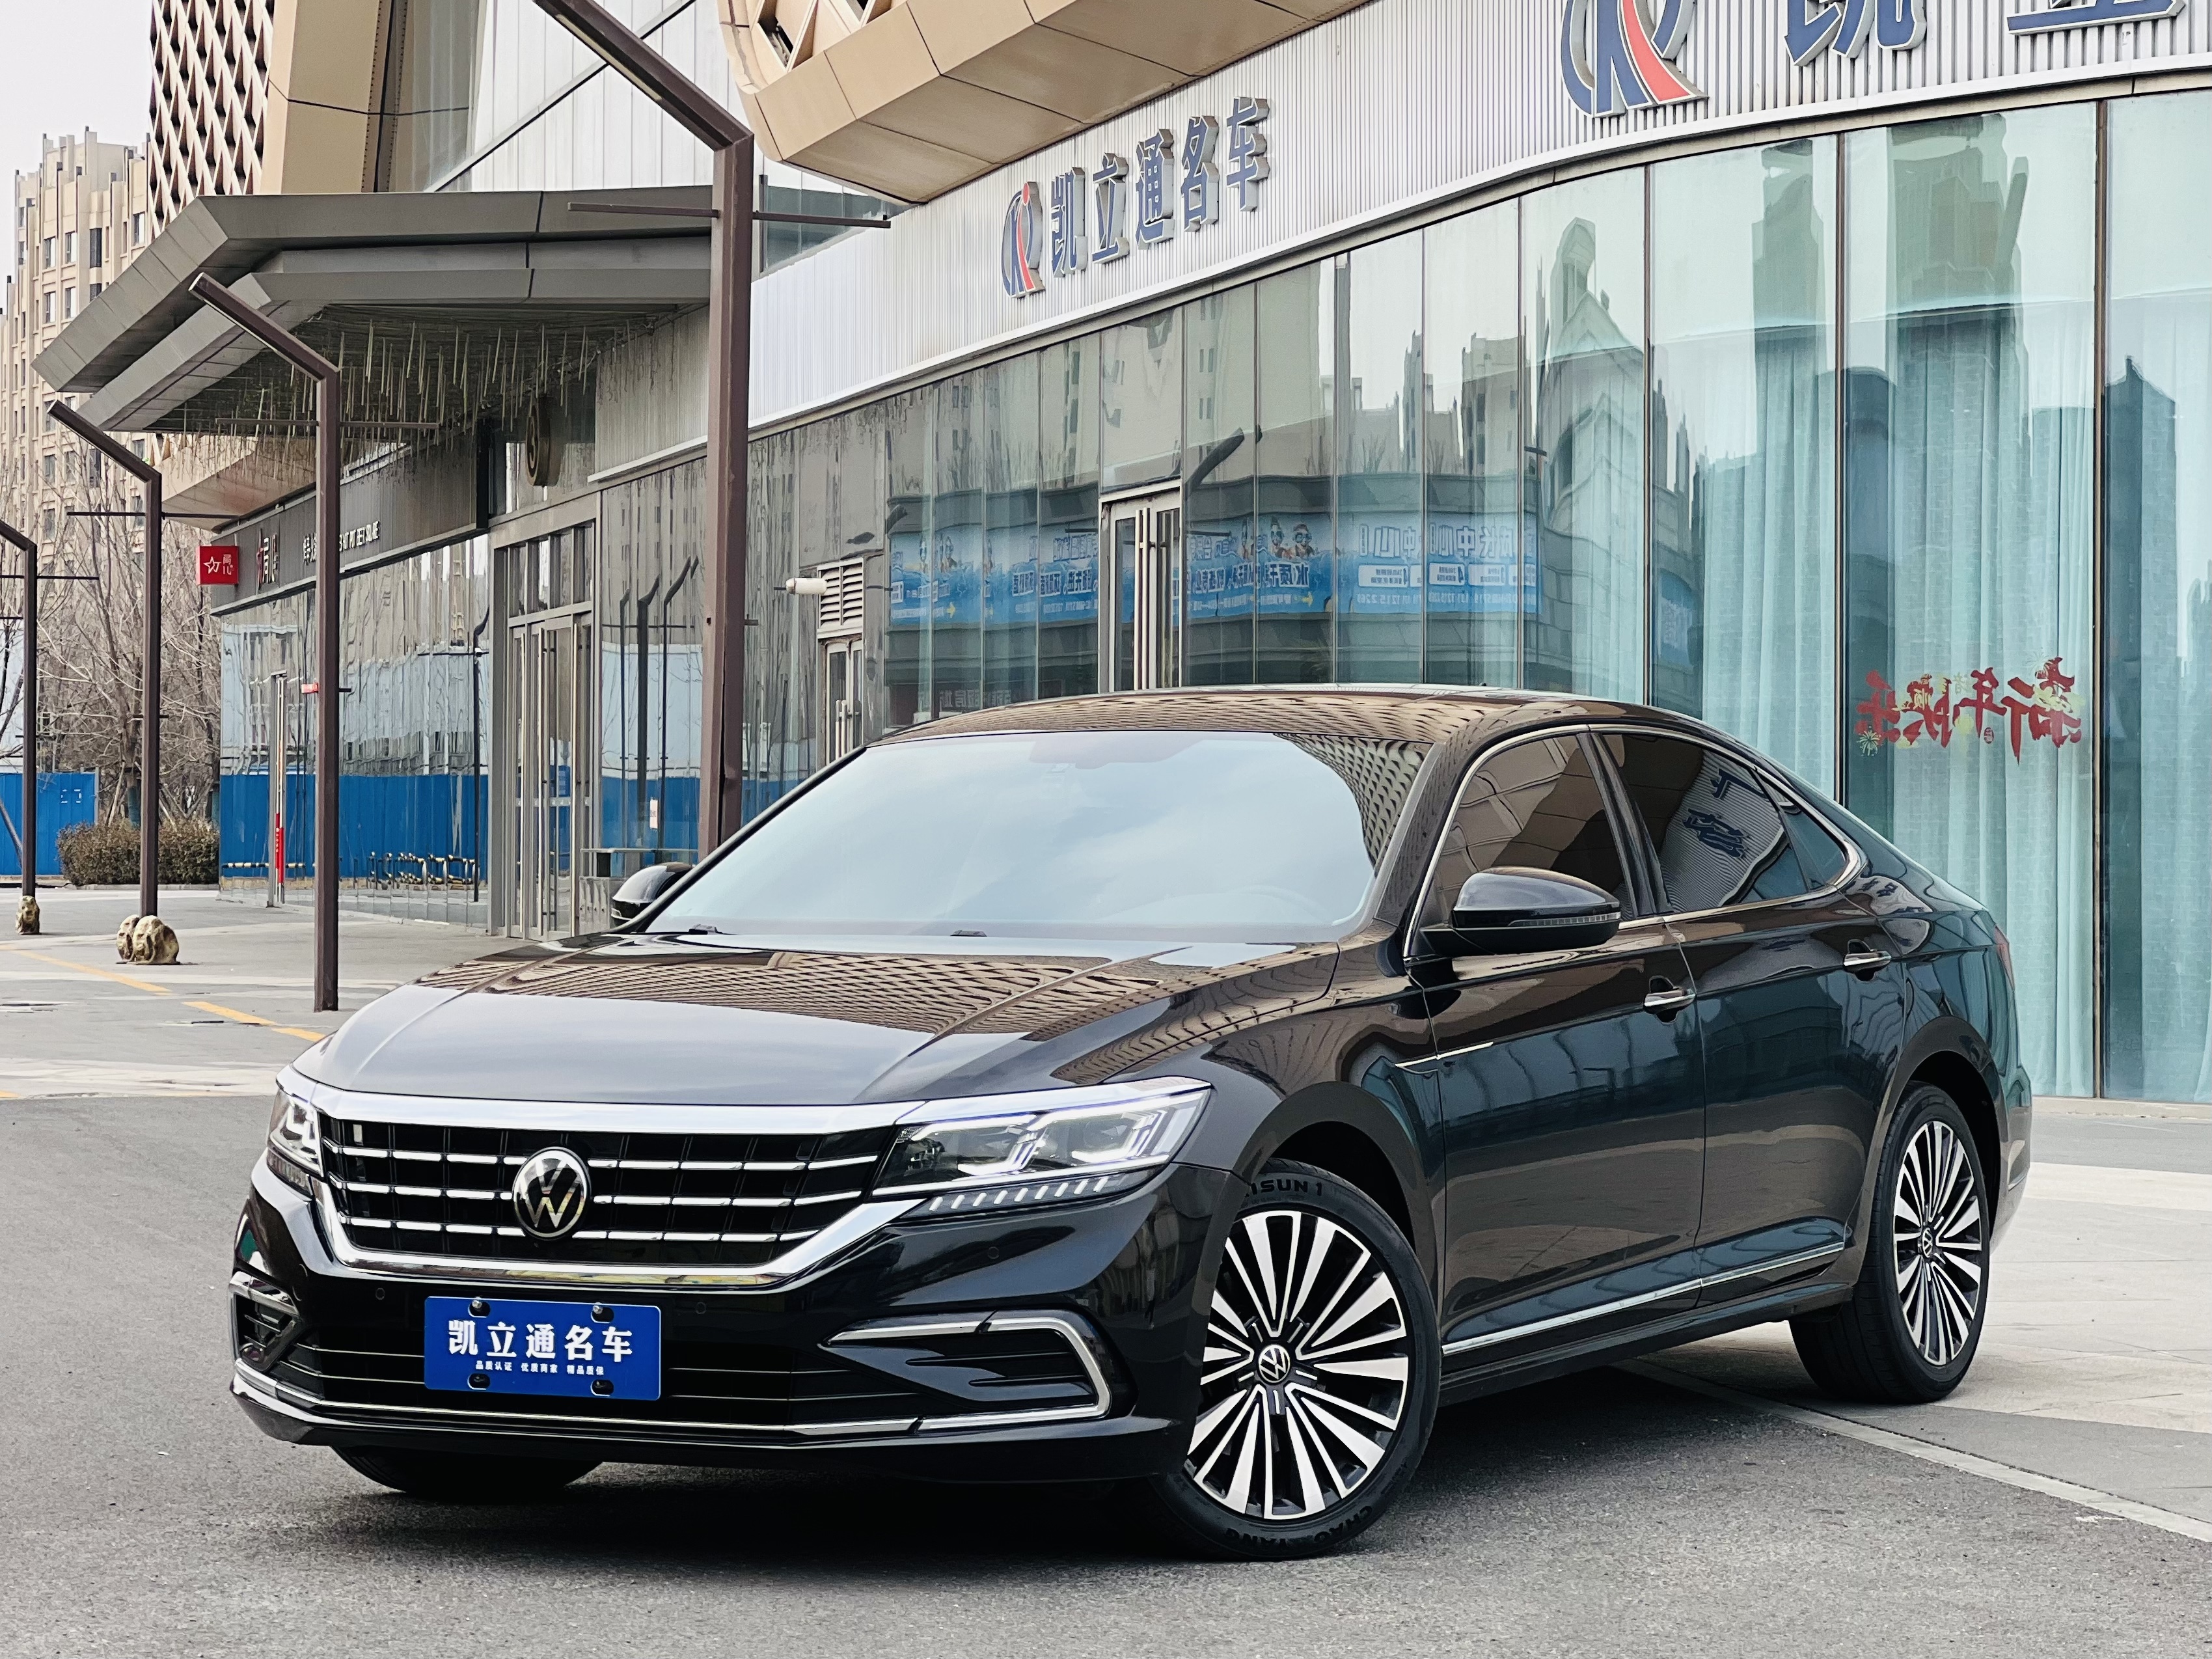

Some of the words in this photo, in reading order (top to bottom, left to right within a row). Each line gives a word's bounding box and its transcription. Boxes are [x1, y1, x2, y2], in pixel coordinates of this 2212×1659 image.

[1051, 96, 1270, 278] 凯立通名车
[1245, 1179, 1308, 1198] ISUN
[448, 1319, 633, 1362] 凯立通名车
